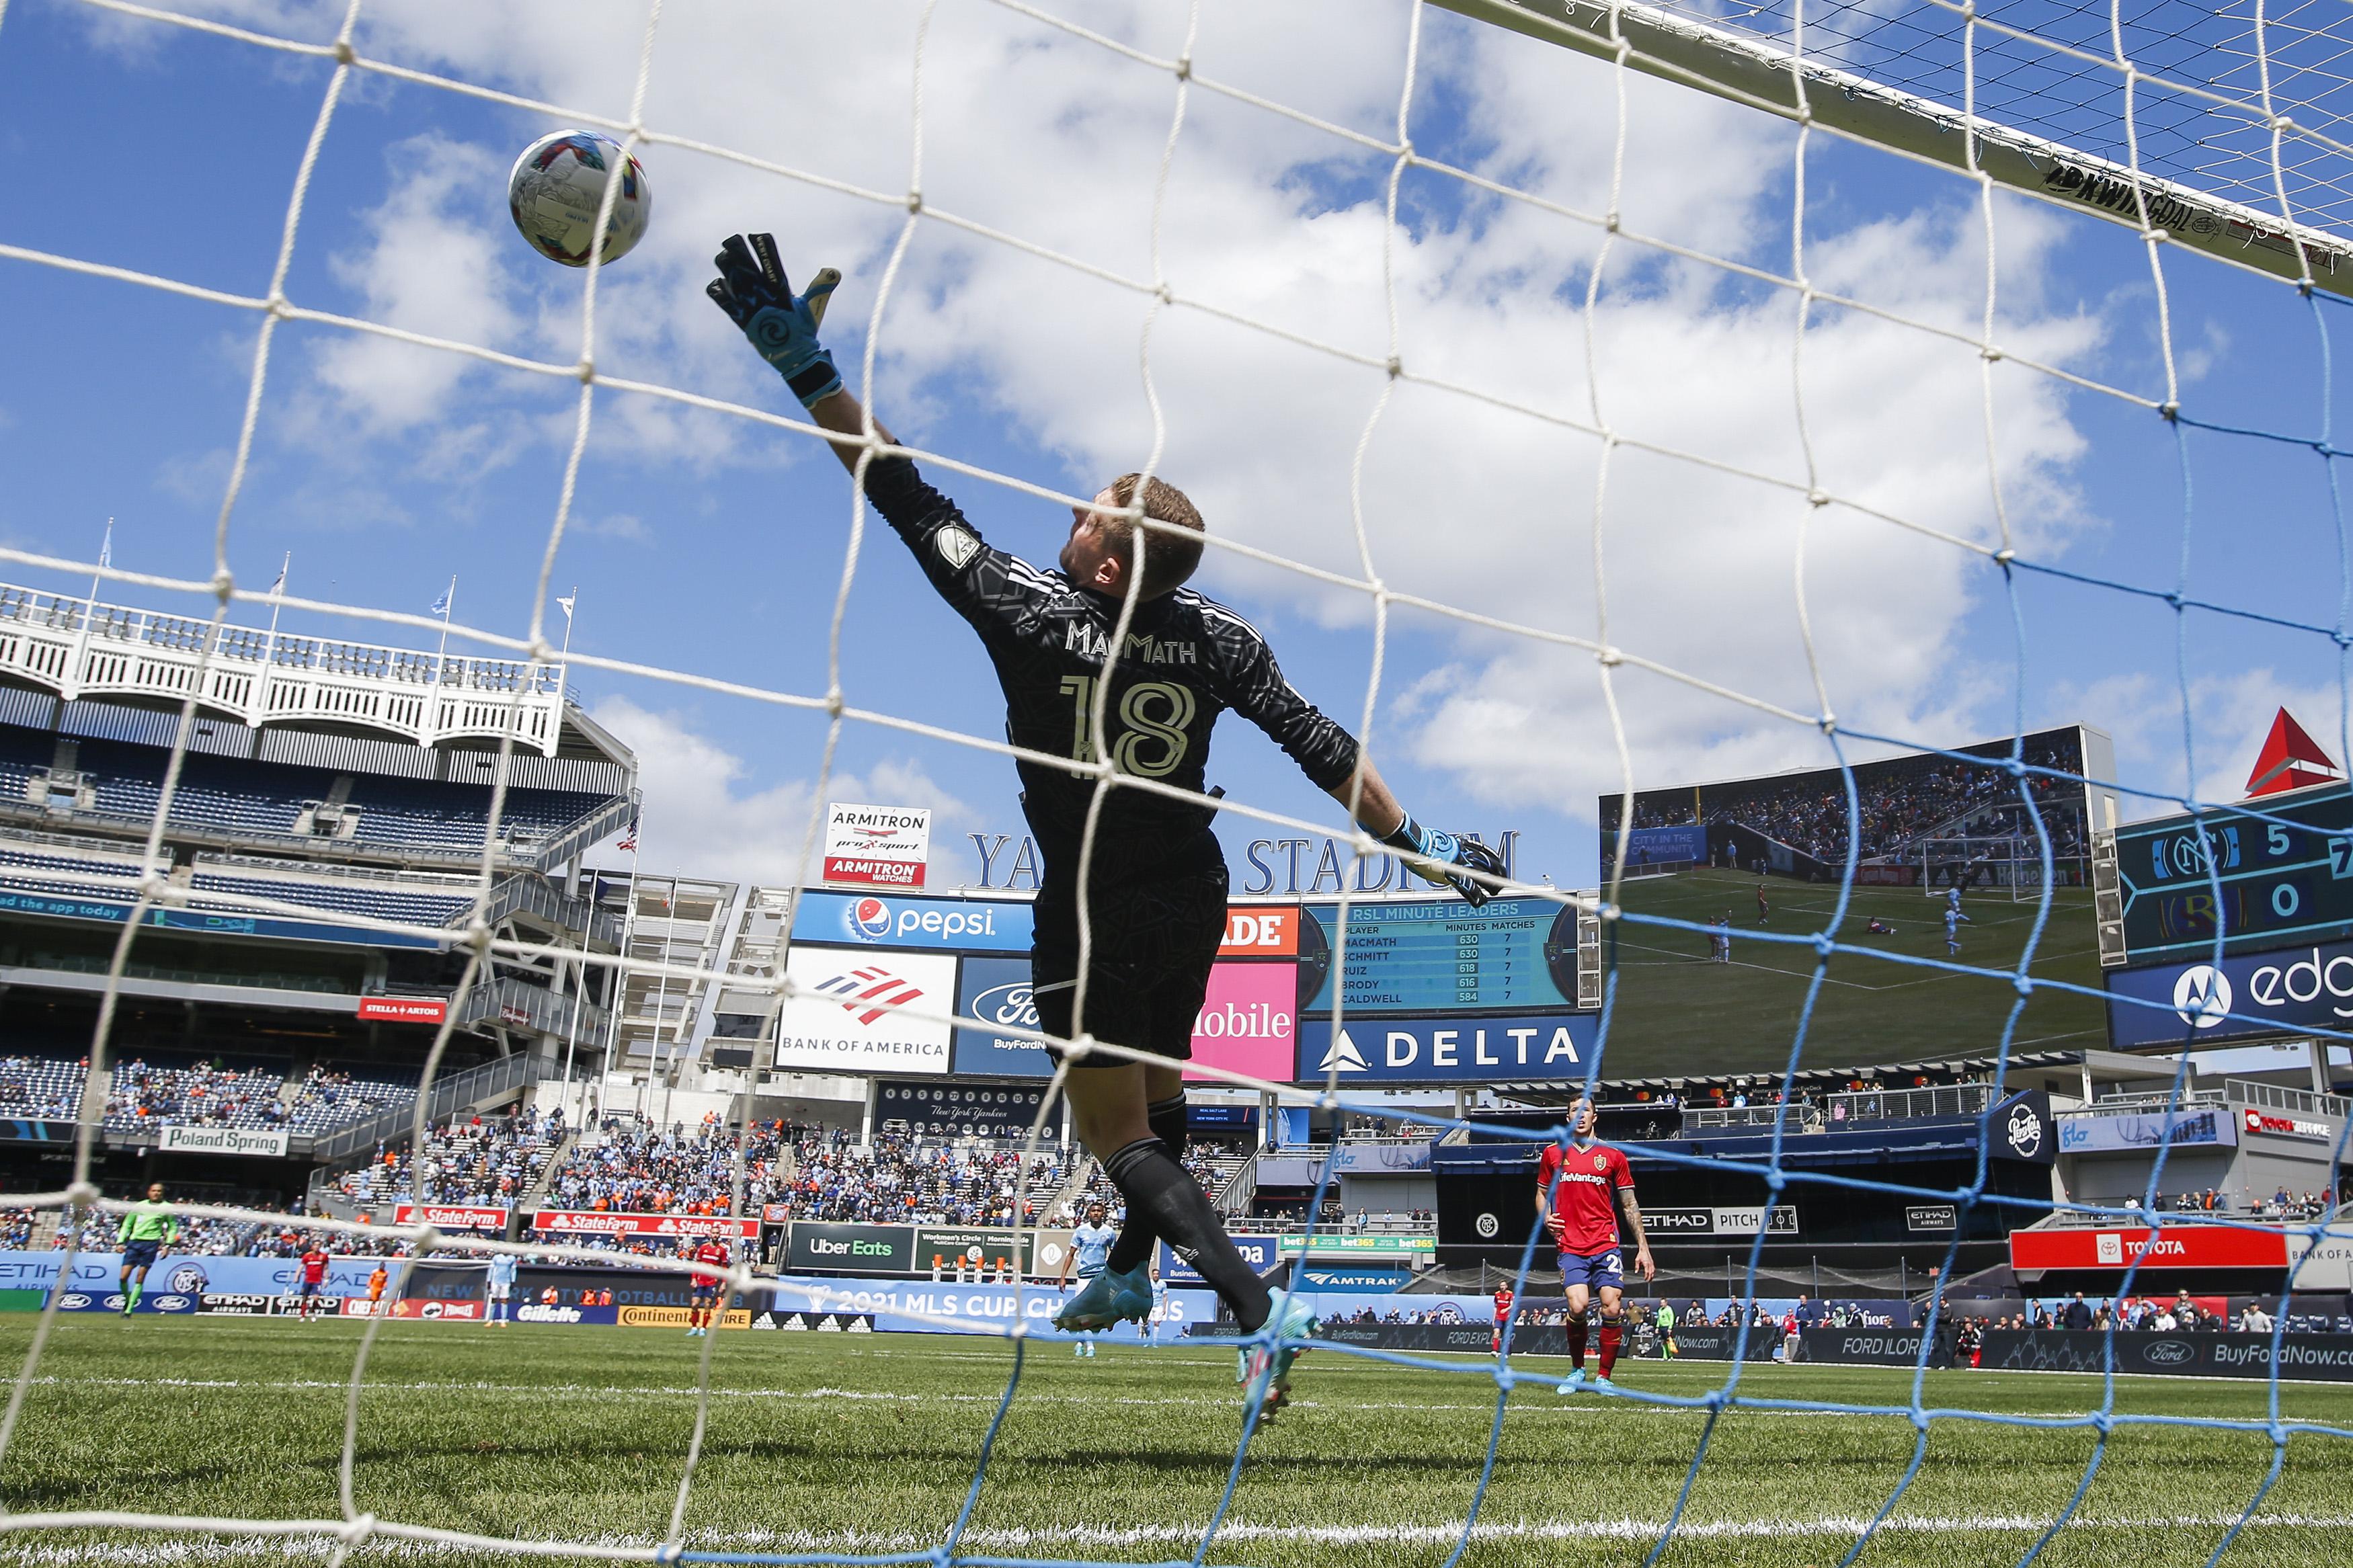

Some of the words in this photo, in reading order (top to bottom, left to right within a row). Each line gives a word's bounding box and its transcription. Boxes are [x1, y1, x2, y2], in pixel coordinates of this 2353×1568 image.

[1060, 675, 1196, 780] 18
[833, 812, 925, 829] ARMITRON
[836, 839, 864, 850] pro
[877, 841, 920, 851] sport
[1633, 835, 1657, 845] CITY
[1660, 835, 1670, 843] IN
[1673, 833, 1693, 842] THE
[2267, 825, 2290, 856] 5
[832, 860, 918, 876] ARMITRON
[872, 873, 914, 883] WATCHES
[1996, 866, 2068, 886] Heineen
[2272, 884, 2299, 917] 0
[20, 898, 44, 909] the
[48, 903, 75, 915] app
[79, 905, 120, 919] today
[1353, 908, 1382, 921] RSL
[1386, 906, 1445, 919] MINUTE
[1448, 903, 1519, 917] LEADERS
[898, 908, 995, 940] pepsi
[1445, 923, 1486, 932] MINUTES
[1491, 921, 1536, 930] MATCHES
[1460, 935, 1478, 944] 630
[1505, 934, 1511, 942] 7
[1460, 949, 1478, 958] 630
[1505, 948, 1511, 956] 7
[1459, 964, 1475, 973] 618
[1505, 962, 1511, 971] 7
[1459, 978, 1476, 987] 616
[1505, 977, 1511, 985] 7
[1341, 994, 1402, 1003] CALDWELL
[1459, 992, 1478, 1001] 584
[1505, 991, 1511, 1000] 7
[366, 1004, 398, 1013] STELLA
[406, 1007, 439, 1016] ARTOIS
[783, 1037, 831, 1051] BANK
[837, 1040, 860, 1052] OF
[864, 1041, 945, 1056] AMERICA
[1386, 1027, 1580, 1068] DELTA
[931, 1105, 951, 1116] New
[951, 1106, 972, 1121] York
[973, 1107, 1007, 1121] Yankees
[169, 1129, 223, 1147] Poland
[227, 1132, 279, 1153] Spring
[2061, 1122, 2089, 1148] flo
[427, 1209, 497, 1225] StateFarm
[1720, 1214, 1759, 1227] PITCH
[1911, 1210, 1951, 1220] ETIHAD
[571, 1214, 639, 1232] StateFarm
[922, 1233, 961, 1242] Workmen's
[961, 1235, 982, 1243] Circle
[1341, 1237, 1375, 1247] bet365
[1398, 1238, 1433, 1248] bet365
[809, 1238, 850, 1255] Uber
[852, 1240, 893, 1256] Eats
[2292, 1250, 2323, 1260] BANK
[2327, 1249, 2342, 1260] OF
[0, 1263, 107, 1279] ETIHAD
[1170, 1270, 1199, 1278] Business
[15, 1283, 80, 1291] AIRWYS
[1329, 1277, 1399, 1286] AMTRAK
[427, 1284, 473, 1298] NEW
[58, 1296, 85, 1307] Ford
[159, 1297, 184, 1308] Ford
[203, 1294, 265, 1306] ETIHAD
[837, 1289, 897, 1313] 2021
[905, 1293, 957, 1315] MLS
[965, 1295, 1019, 1317] CUP
[517, 1304, 583, 1323] Gillette
[623, 1307, 693, 1325] Continent
[752, 1322, 776, 1330] adidas
[783, 1323, 807, 1331] adidas
[817, 1323, 842, 1333] adidas
[847, 1325, 871, 1333] adidas
[1331, 1330, 1379, 1341] BuyFordNow.com
[1447, 1331, 1470, 1344] FORD
[1841, 1337, 1883, 1355] FORD
[2151, 1344, 2185, 1362] Ford
